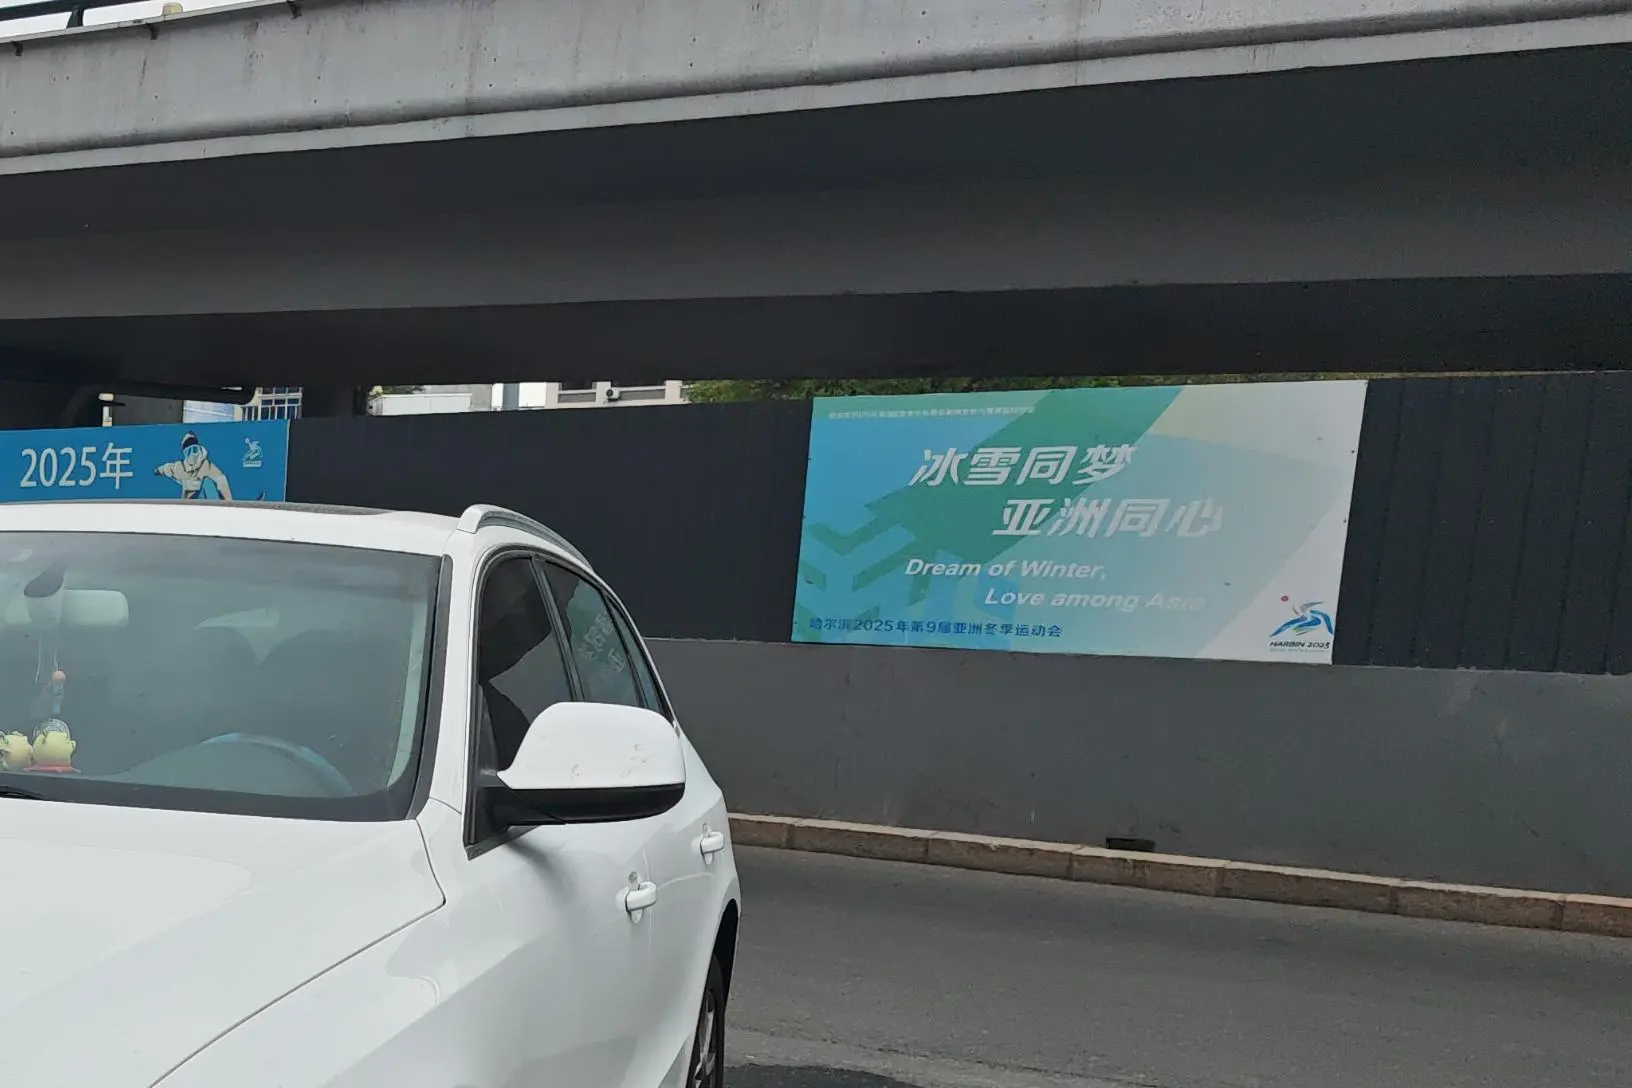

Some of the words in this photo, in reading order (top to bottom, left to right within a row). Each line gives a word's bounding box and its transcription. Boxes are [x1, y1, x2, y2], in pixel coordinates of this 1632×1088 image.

[20, 442, 134, 490] 2025年
[908, 444, 1138, 487] 冰雪同梦
[991, 497, 1224, 539] 亚洲同心
[904, 558, 981, 577] Dream
[987, 560, 1020, 577] of
[1020, 560, 1107, 581] Winter,
[984, 587, 1045, 606] Love
[1050, 593, 1140, 613] among
[1146, 591, 1207, 612] Asia
[809, 617, 1063, 638] 哈尔滨2025年第9届亚洲冬季运动会
